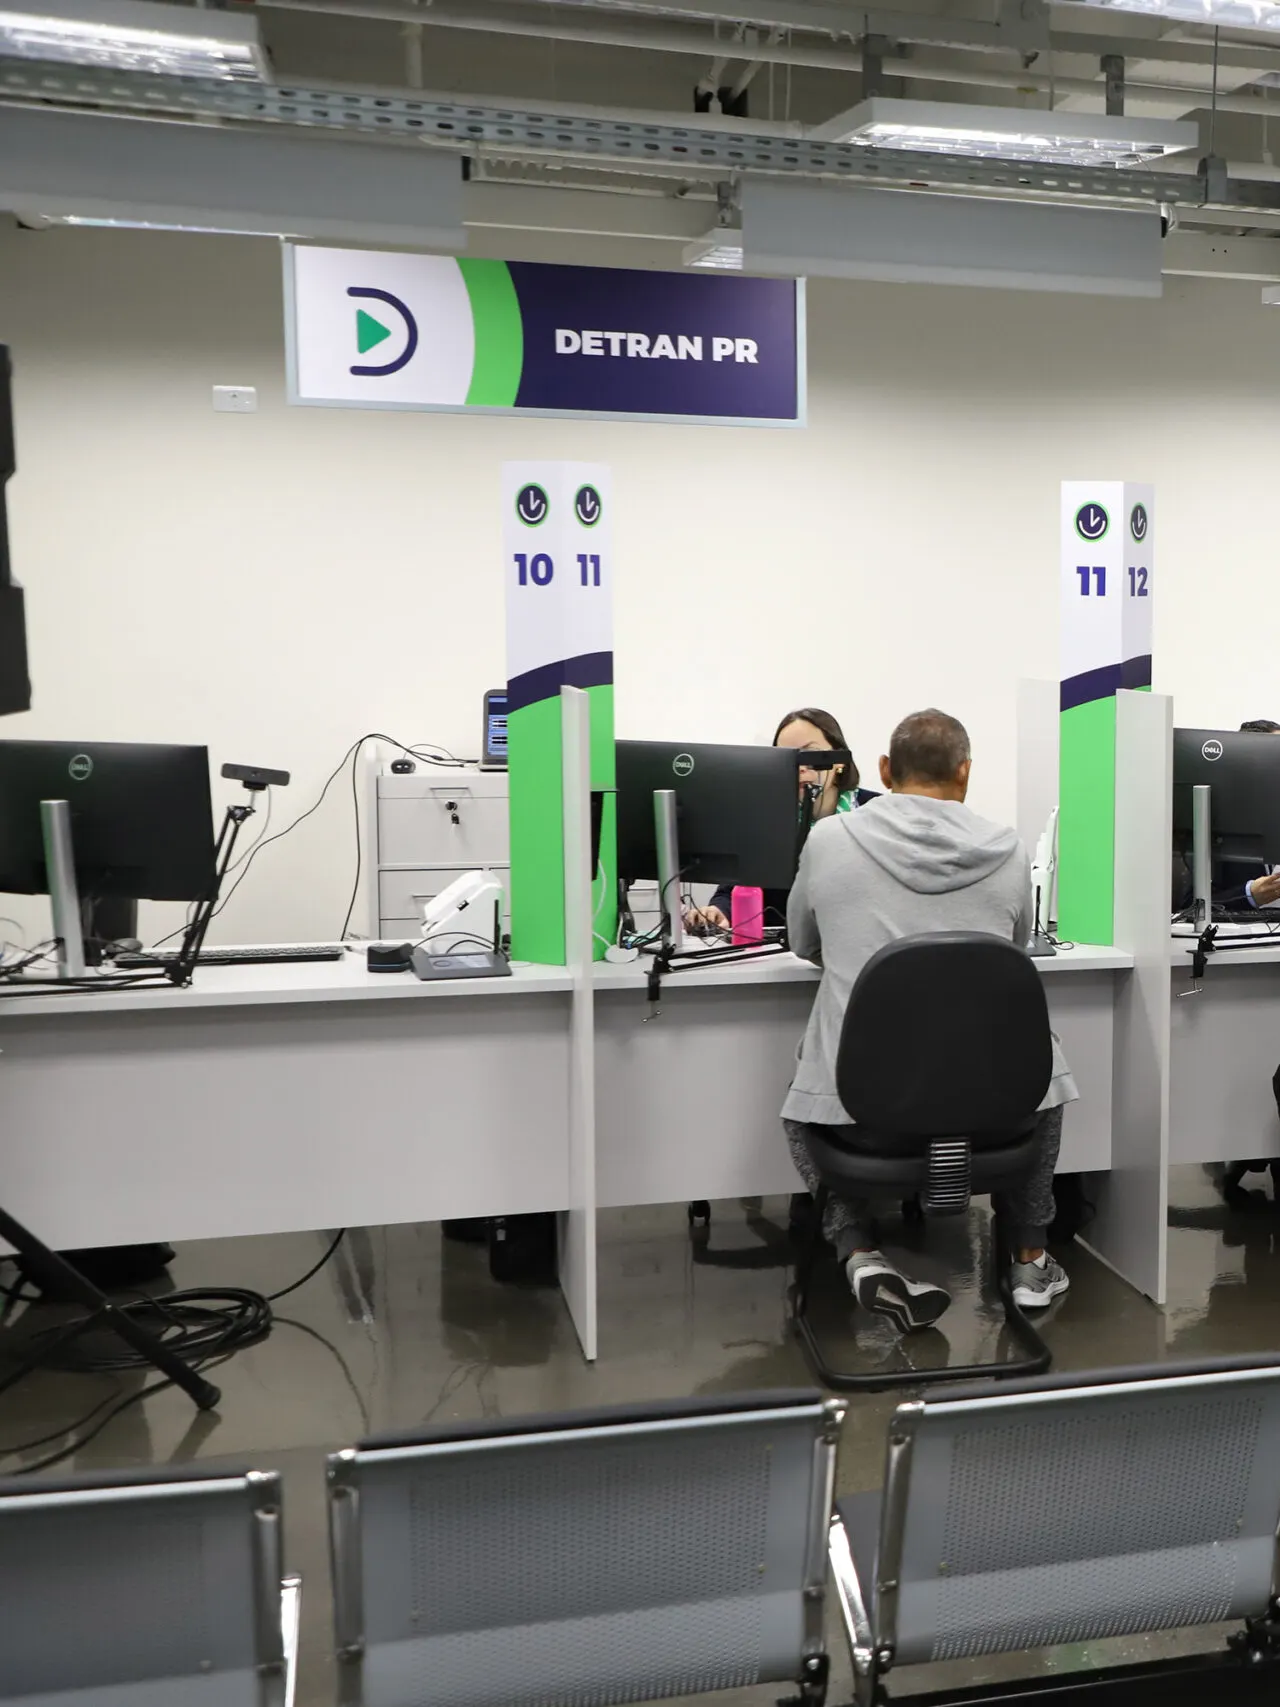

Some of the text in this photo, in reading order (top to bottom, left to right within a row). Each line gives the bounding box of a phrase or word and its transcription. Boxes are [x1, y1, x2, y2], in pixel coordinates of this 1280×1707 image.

[555, 328, 759, 364] DETRAN PR
[513, 553, 554, 586] 10
[576, 554, 600, 587] 11
[1076, 566, 1106, 596] 11
[1128, 566, 1148, 596] 12
[1204, 746, 1220, 754] DELL
